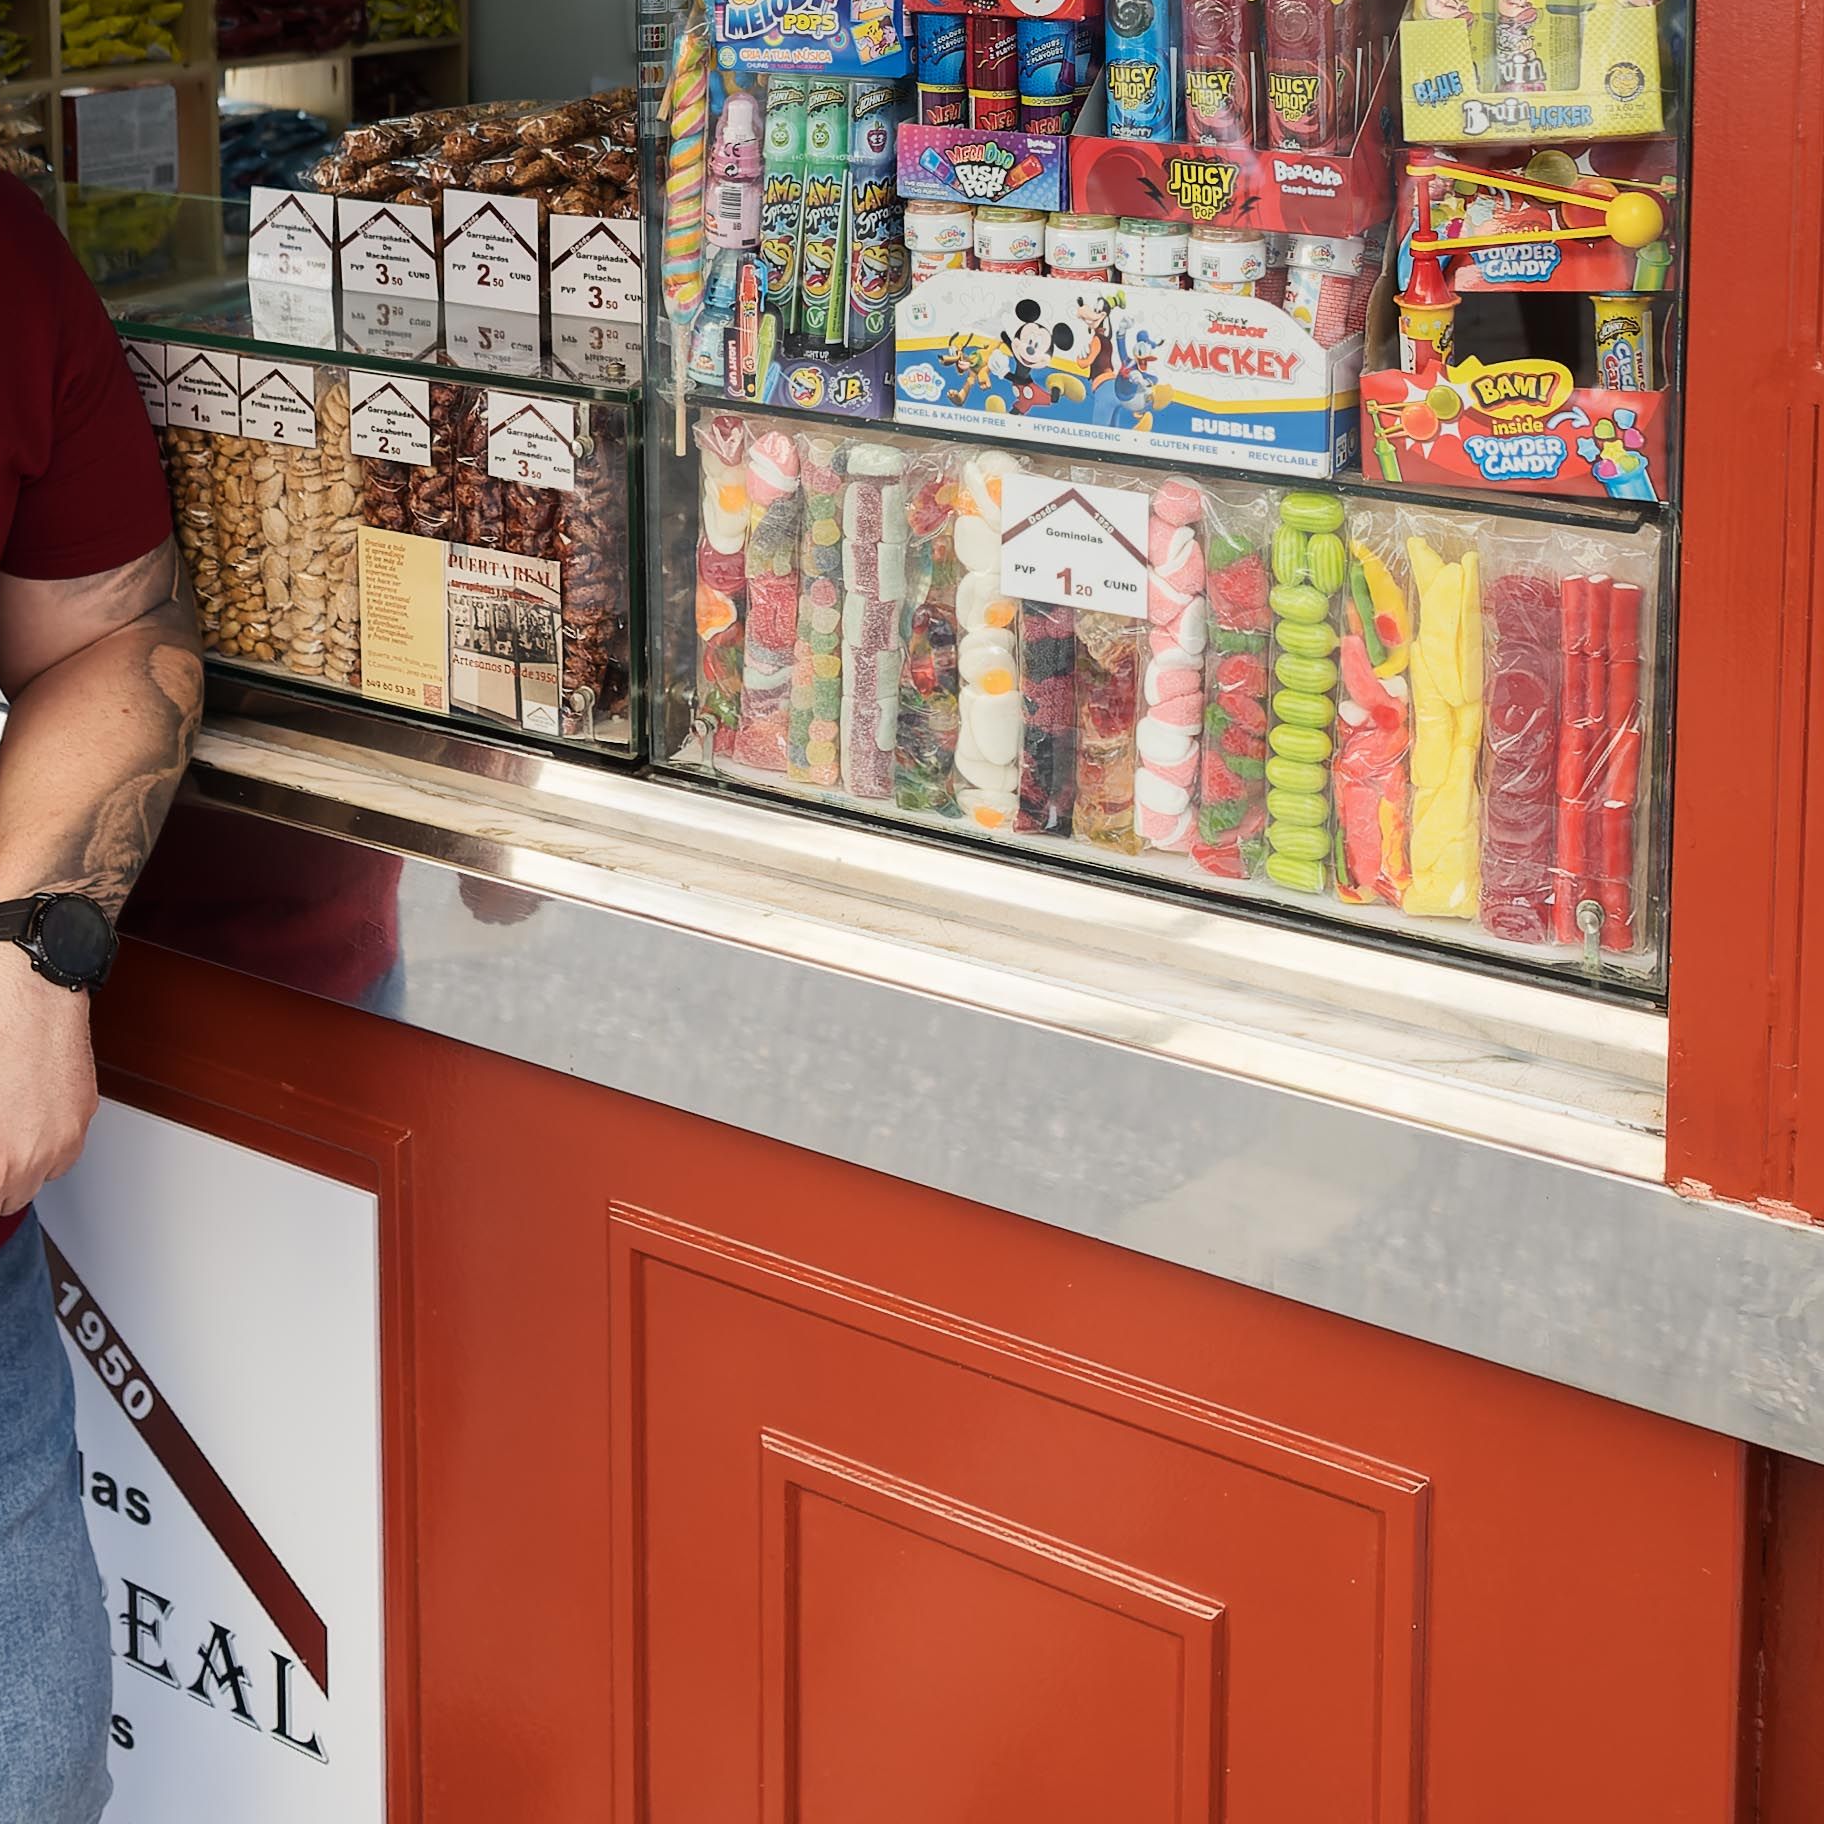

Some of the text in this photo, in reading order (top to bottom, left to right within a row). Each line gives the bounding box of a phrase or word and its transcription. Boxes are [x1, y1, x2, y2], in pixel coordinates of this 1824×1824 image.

[783, 13, 836, 33] POPS
[1413, 70, 1463, 105] BLUE
[1463, 97, 1592, 134] Brain LICKER
[1171, 162, 1235, 193] JUICY
[1181, 183, 1223, 207] DROP
[1193, 205, 1214, 219] POP
[1166, 341, 1299, 380] MICKEY
[1474, 373, 1556, 405] BAM!
[898, 406, 930, 418] NICKEL
[940, 412, 980, 424] KATHON
[983, 417, 1006, 428] FREE
[1033, 424, 1120, 442] HYPOALLERGENIC
[1150, 438, 1190, 452] GLUTEN
[1192, 442, 1218, 455] FREE
[1249, 451, 1318, 466] RECYCLABLE
[1191, 417, 1276, 442] BUBBLES
[1493, 417, 1544, 436] inside
[1469, 438, 1562, 458] POWDER
[1484, 454, 1558, 474] CANDY
[1028, 503, 1057, 525] Desde
[1093, 512, 1115, 534] 1950
[1046, 527, 1103, 544] Gominolas
[1014, 564, 1137, 597] PVP 1 20 €/UND
[56, 1279, 155, 1422] 1950
[102, 1578, 329, 1764] EAL
